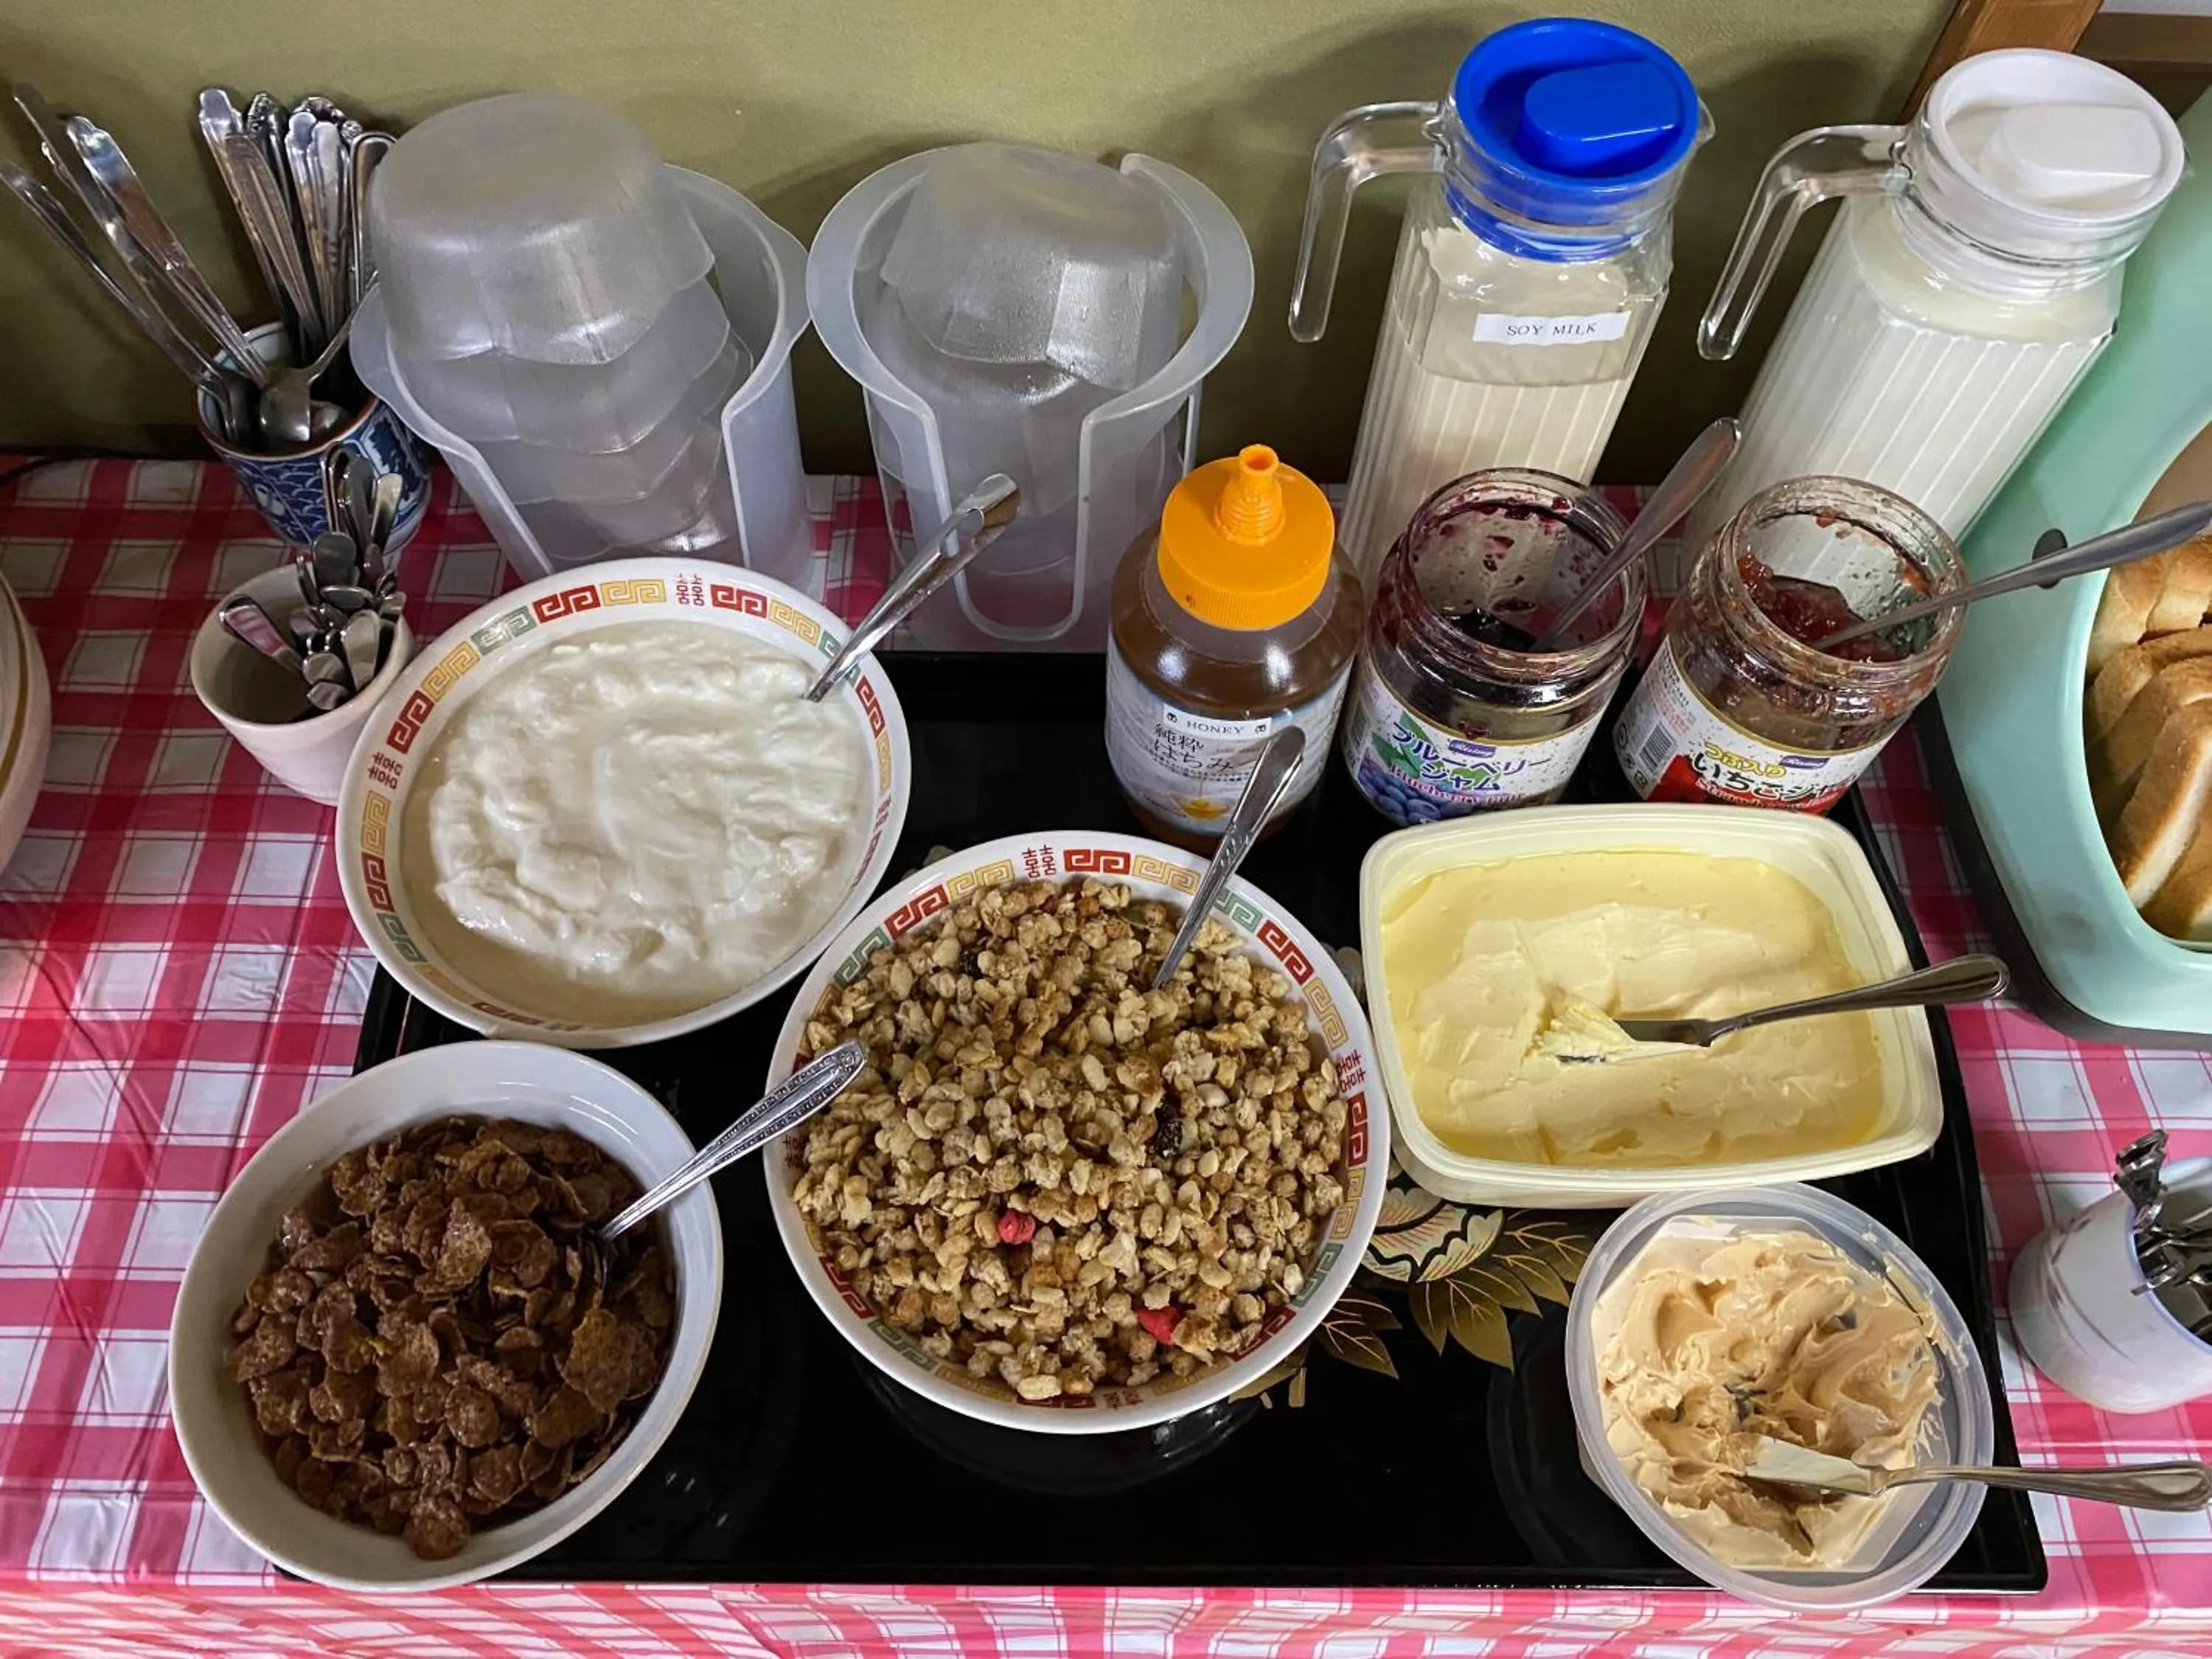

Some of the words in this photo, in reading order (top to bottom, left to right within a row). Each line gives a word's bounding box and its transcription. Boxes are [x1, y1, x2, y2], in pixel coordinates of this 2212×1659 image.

[1506, 324, 1543, 336] SOY
[1552, 321, 1599, 335] MILK
[1186, 720, 1245, 734] HONEY
[1391, 721, 1551, 776] ブルーベリー
[1421, 762, 1501, 791] ジャム
